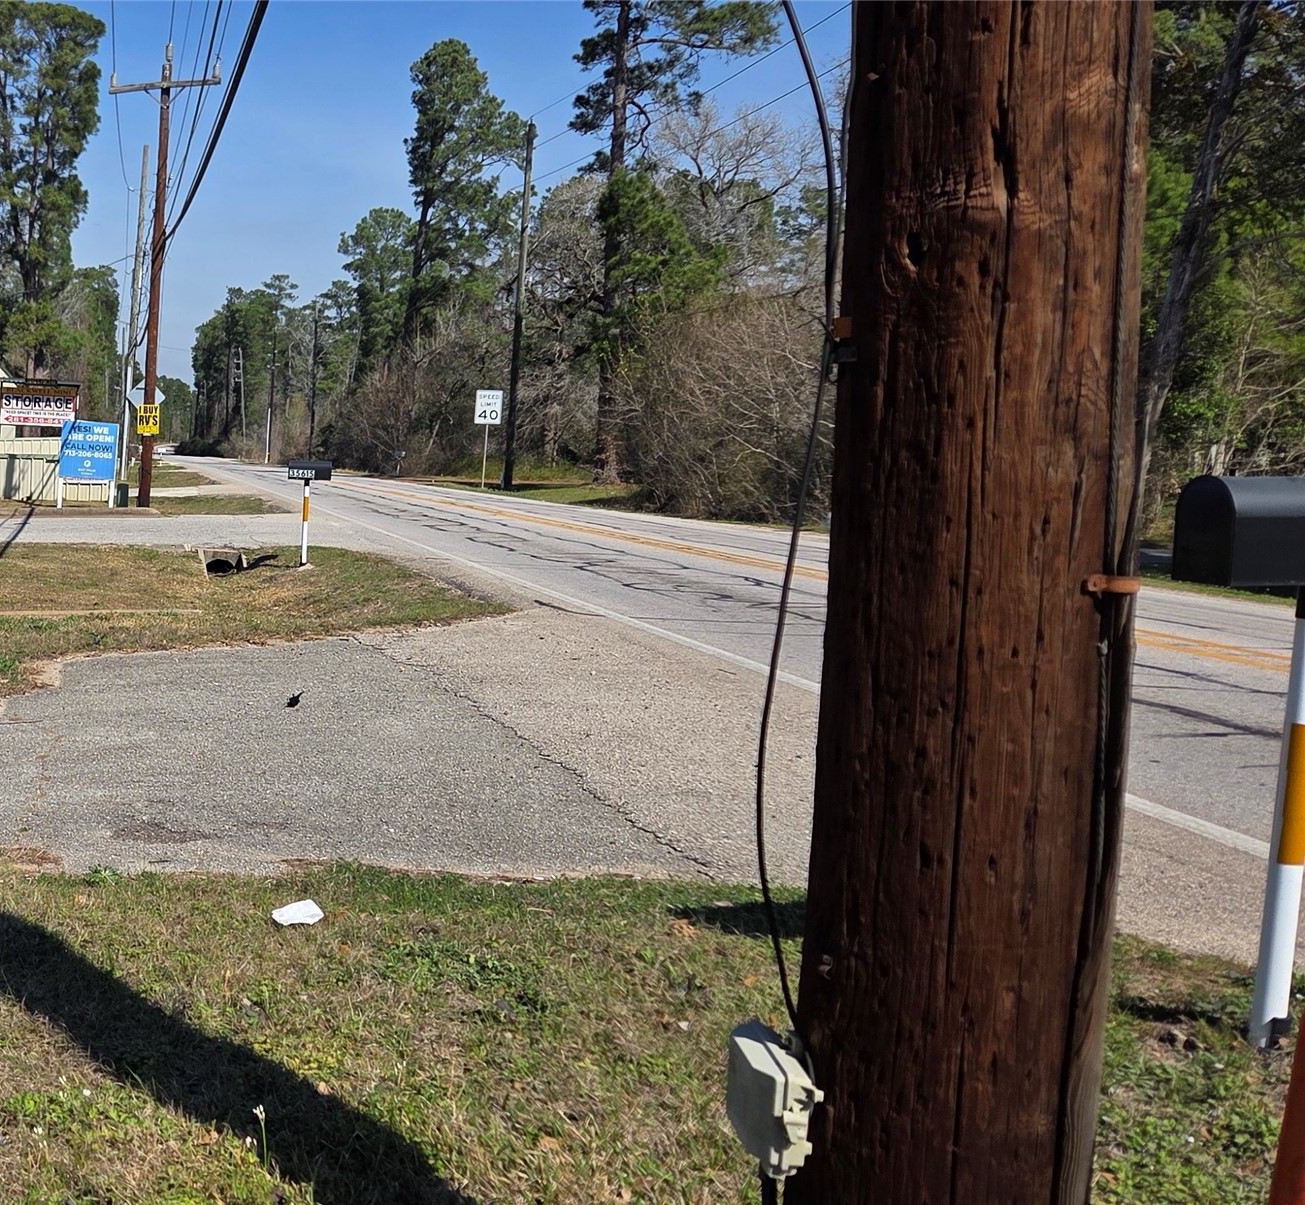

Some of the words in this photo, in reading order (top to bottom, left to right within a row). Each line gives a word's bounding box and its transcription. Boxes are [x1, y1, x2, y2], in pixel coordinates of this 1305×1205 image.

[4, 395, 72, 409] STORAGE
[139, 405, 142, 414] I
[143, 405, 159, 414] BUY
[478, 409, 499, 421] 40
[73, 425, 91, 433] YES!
[93, 426, 110, 434] WE
[86, 434, 114, 442] OPEN!
[65, 442, 86, 450] CALL
[88, 444, 113, 452] NOW!
[64, 450, 113, 459] 713-206-8065
[290, 469, 314, 478] 35615
